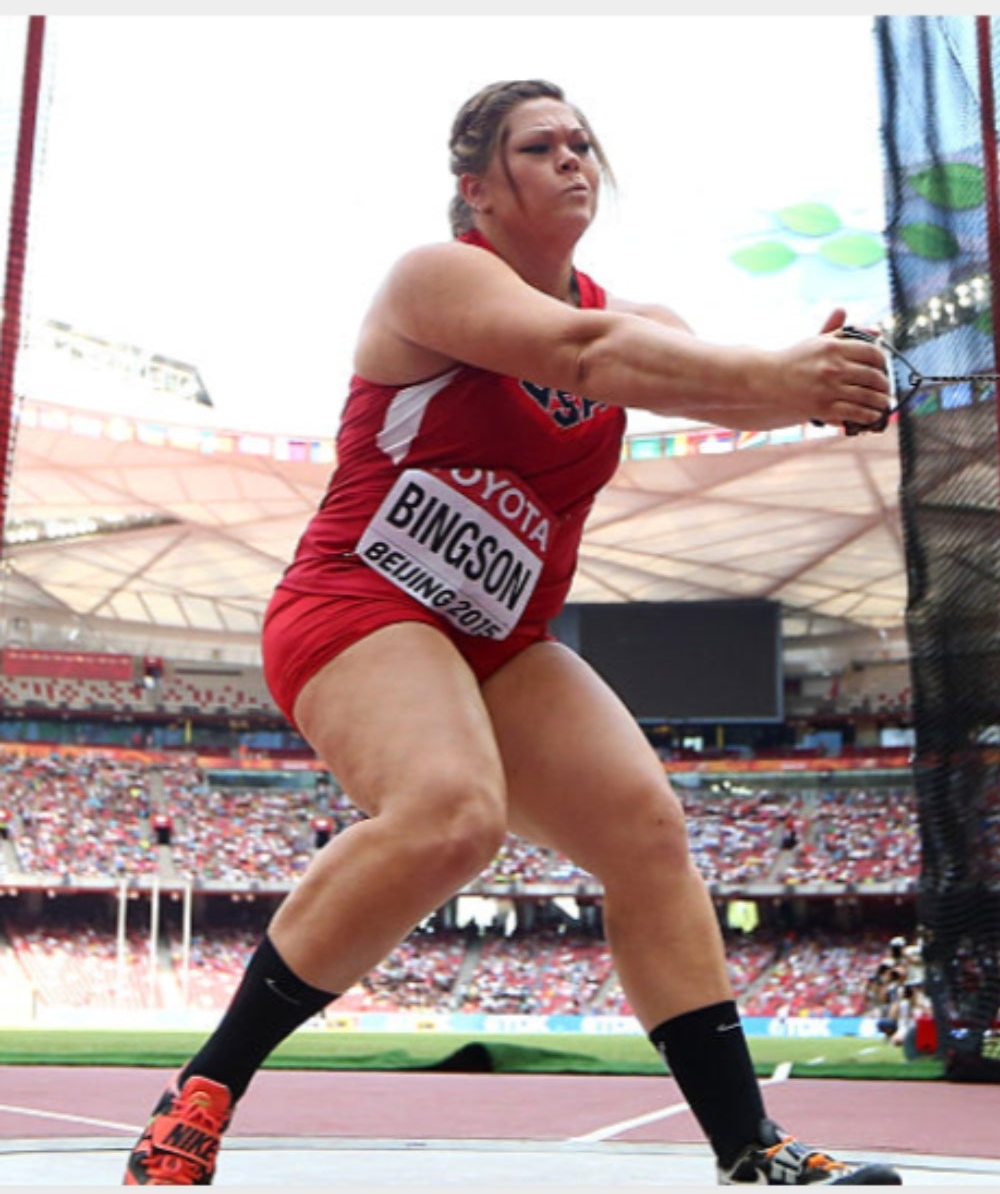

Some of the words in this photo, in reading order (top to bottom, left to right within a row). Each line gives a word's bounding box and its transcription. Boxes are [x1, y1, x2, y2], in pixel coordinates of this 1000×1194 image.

[386, 481, 532, 611] BINGSON
[449, 467, 550, 552] OYOTA
[364, 541, 457, 606] BEIJING
[447, 600, 503, 639] 2015
